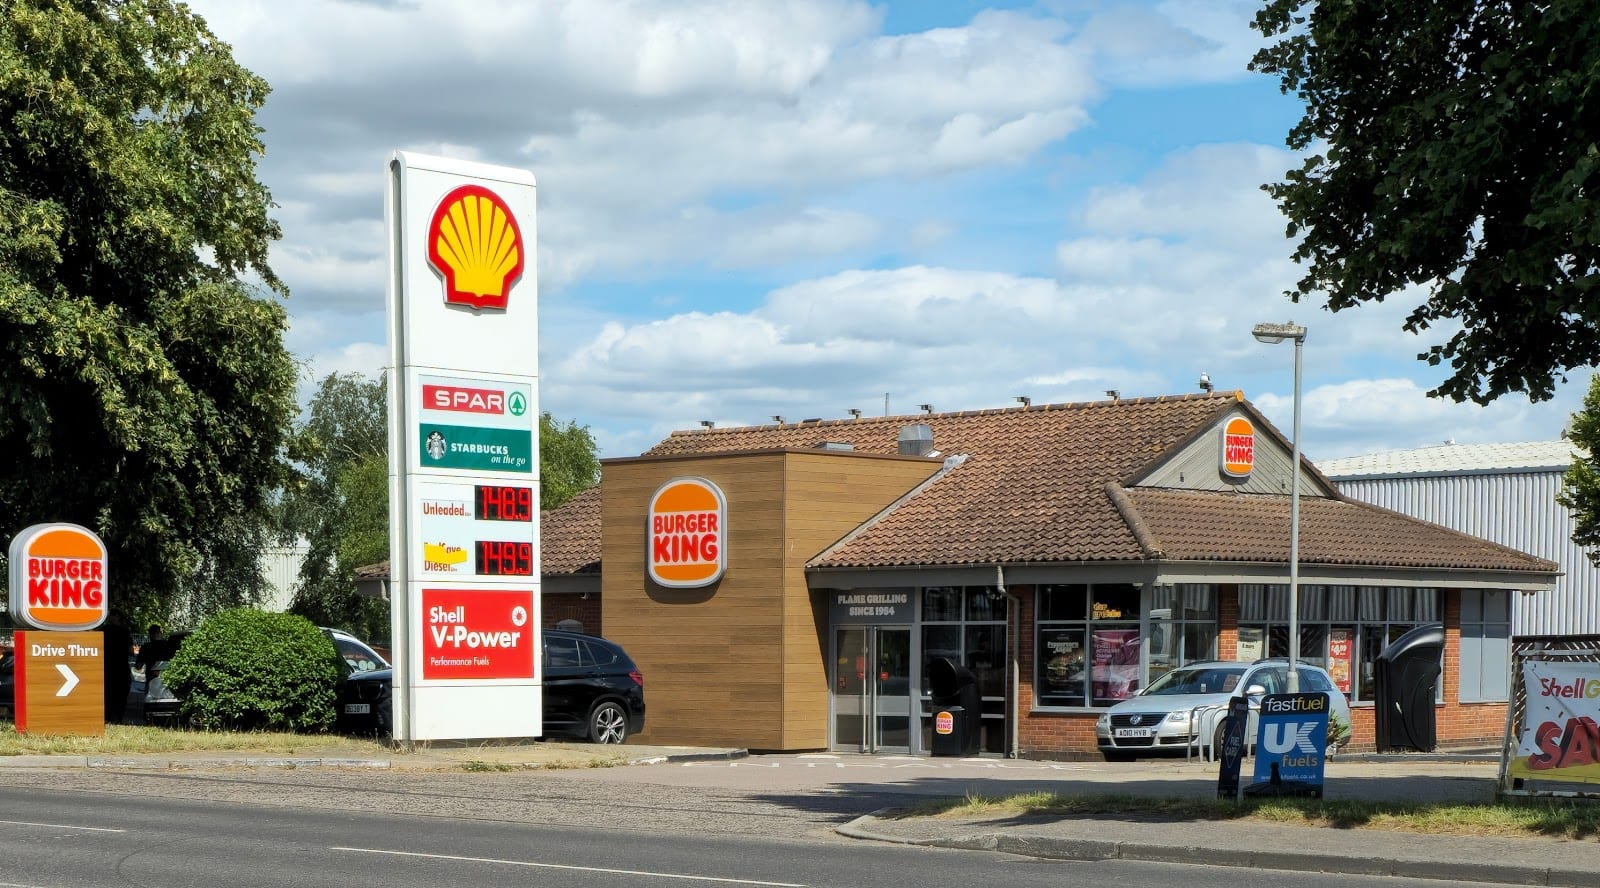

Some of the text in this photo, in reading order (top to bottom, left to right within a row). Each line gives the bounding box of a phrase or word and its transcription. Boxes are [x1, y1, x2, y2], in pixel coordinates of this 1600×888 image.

[435, 390, 503, 411] SPAR
[451, 443, 508, 455] STARBUCKS
[1226, 435, 1253, 447] BURGER
[491, 455, 526, 466] on the go
[1226, 447, 1253, 463] KING
[423, 502, 465, 516] Unleaded
[653, 513, 718, 534] BURGER
[653, 533, 718, 563] KING
[28, 558, 103, 580] BURGER
[28, 578, 103, 608] KING
[838, 593, 908, 604] FLAME GRILLING
[430, 606, 465, 623] Shell
[849, 606, 895, 616] SINCE 1954
[430, 625, 521, 648] V-Power
[32, 644, 98, 657] Drive Thru
[430, 656, 490, 666] Performance Fuels
[1265, 696, 1324, 712] fastfuel
[1263, 721, 1320, 754] UK
[1528, 716, 1600, 771] SA
[1282, 754, 1319, 768] fuels
